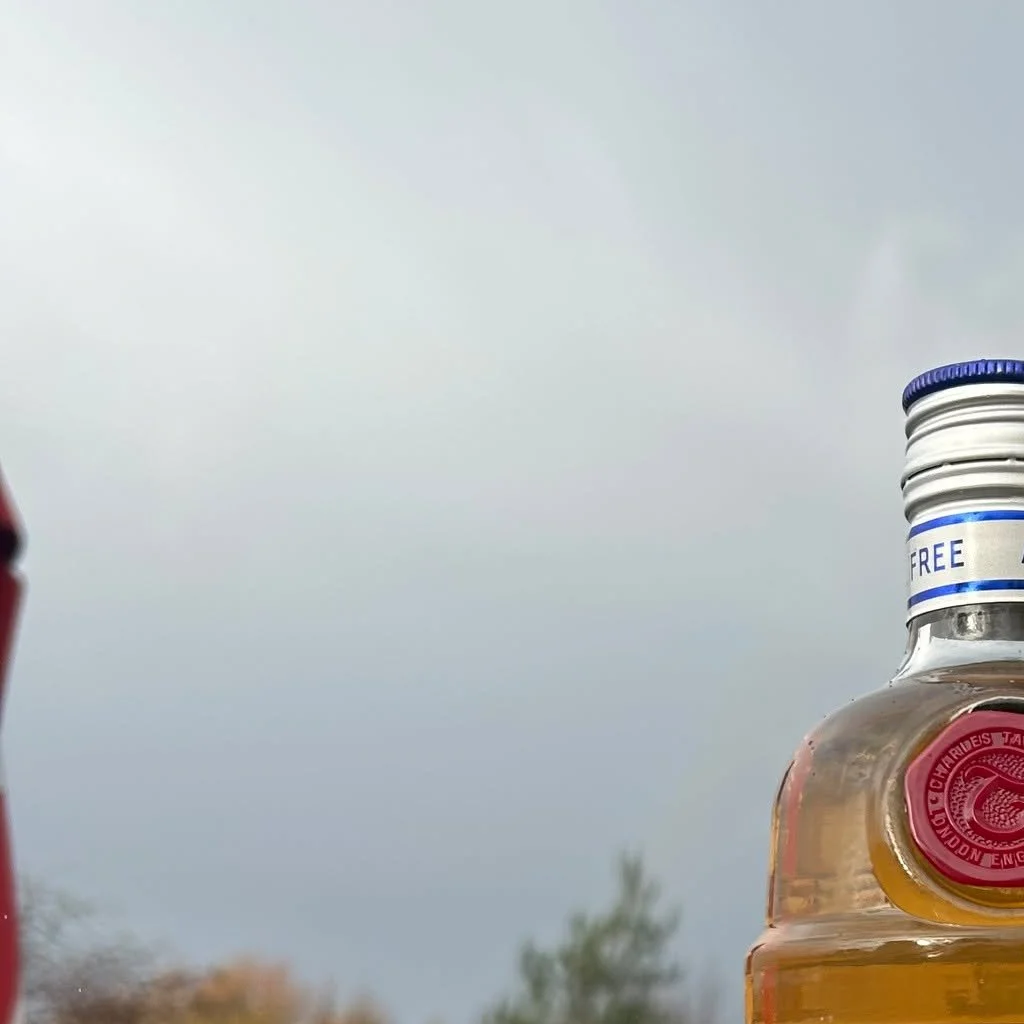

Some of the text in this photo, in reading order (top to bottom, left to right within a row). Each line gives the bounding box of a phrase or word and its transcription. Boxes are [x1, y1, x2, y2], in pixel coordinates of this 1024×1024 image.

[910, 539, 965, 580] FREE
[930, 732, 992, 793] CHARLES
[929, 808, 982, 863] LONDON
